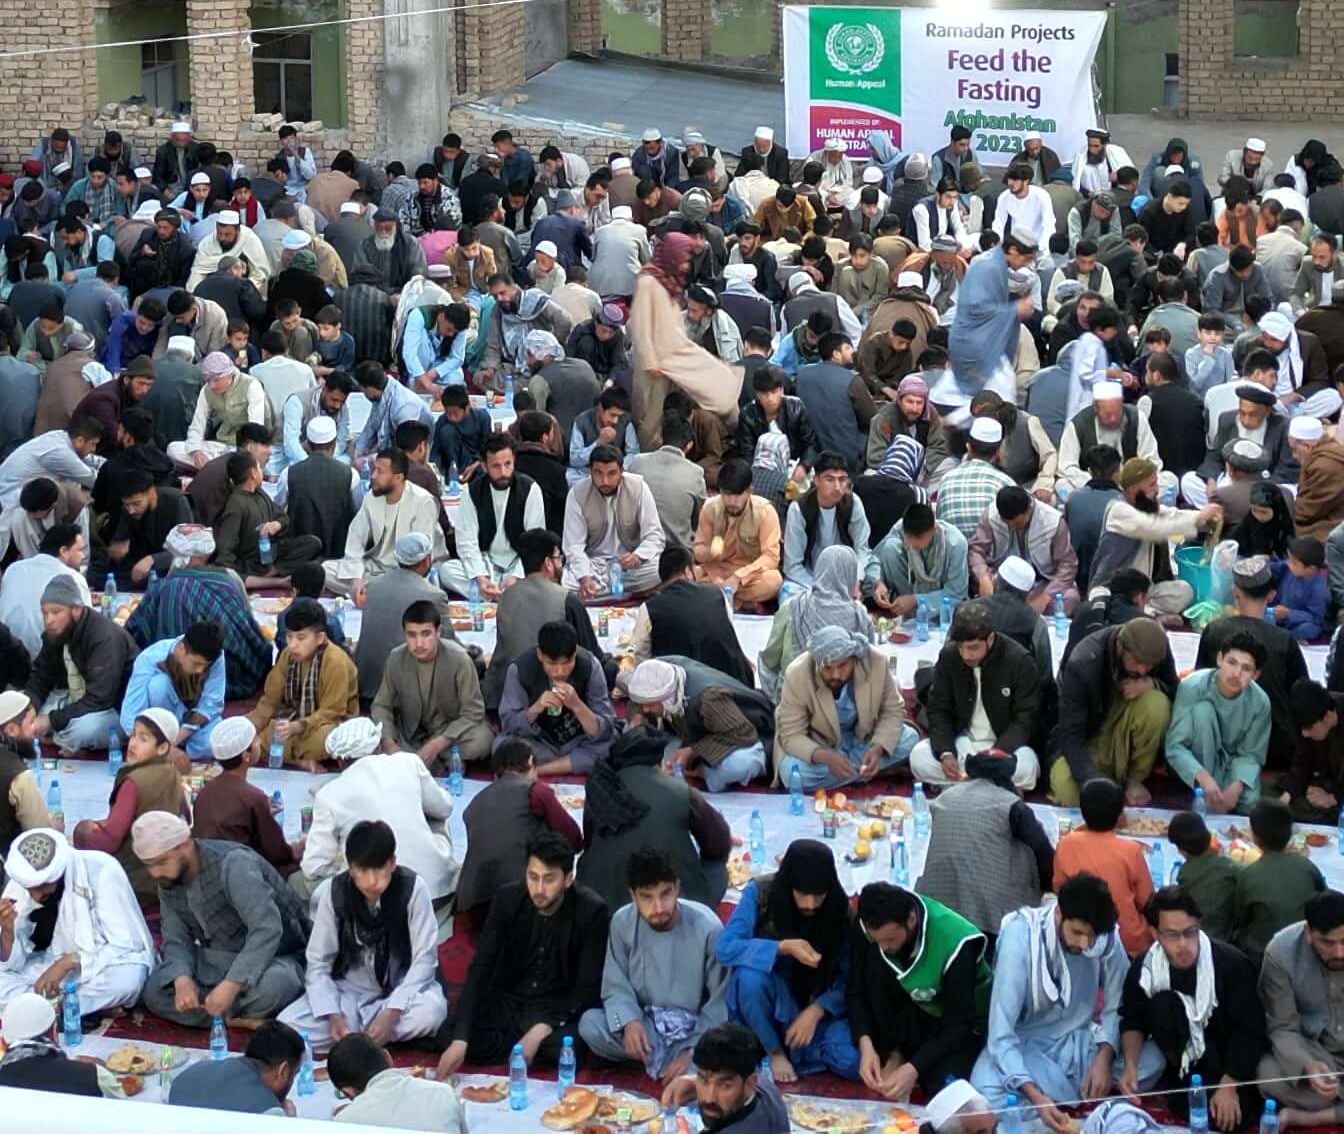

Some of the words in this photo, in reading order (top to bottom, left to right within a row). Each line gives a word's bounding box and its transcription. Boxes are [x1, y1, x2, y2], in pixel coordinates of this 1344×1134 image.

[926, 22, 1004, 39] Ramadan
[1011, 24, 1076, 44] Projects
[948, 48, 1004, 72] Feed
[1012, 48, 1052, 73] the
[958, 78, 1041, 109] Fasting
[943, 109, 1057, 133] Afghanistan
[816, 128, 855, 139] HUMAN
[857, 129, 895, 139] APL
[975, 134, 1023, 154] 2023
